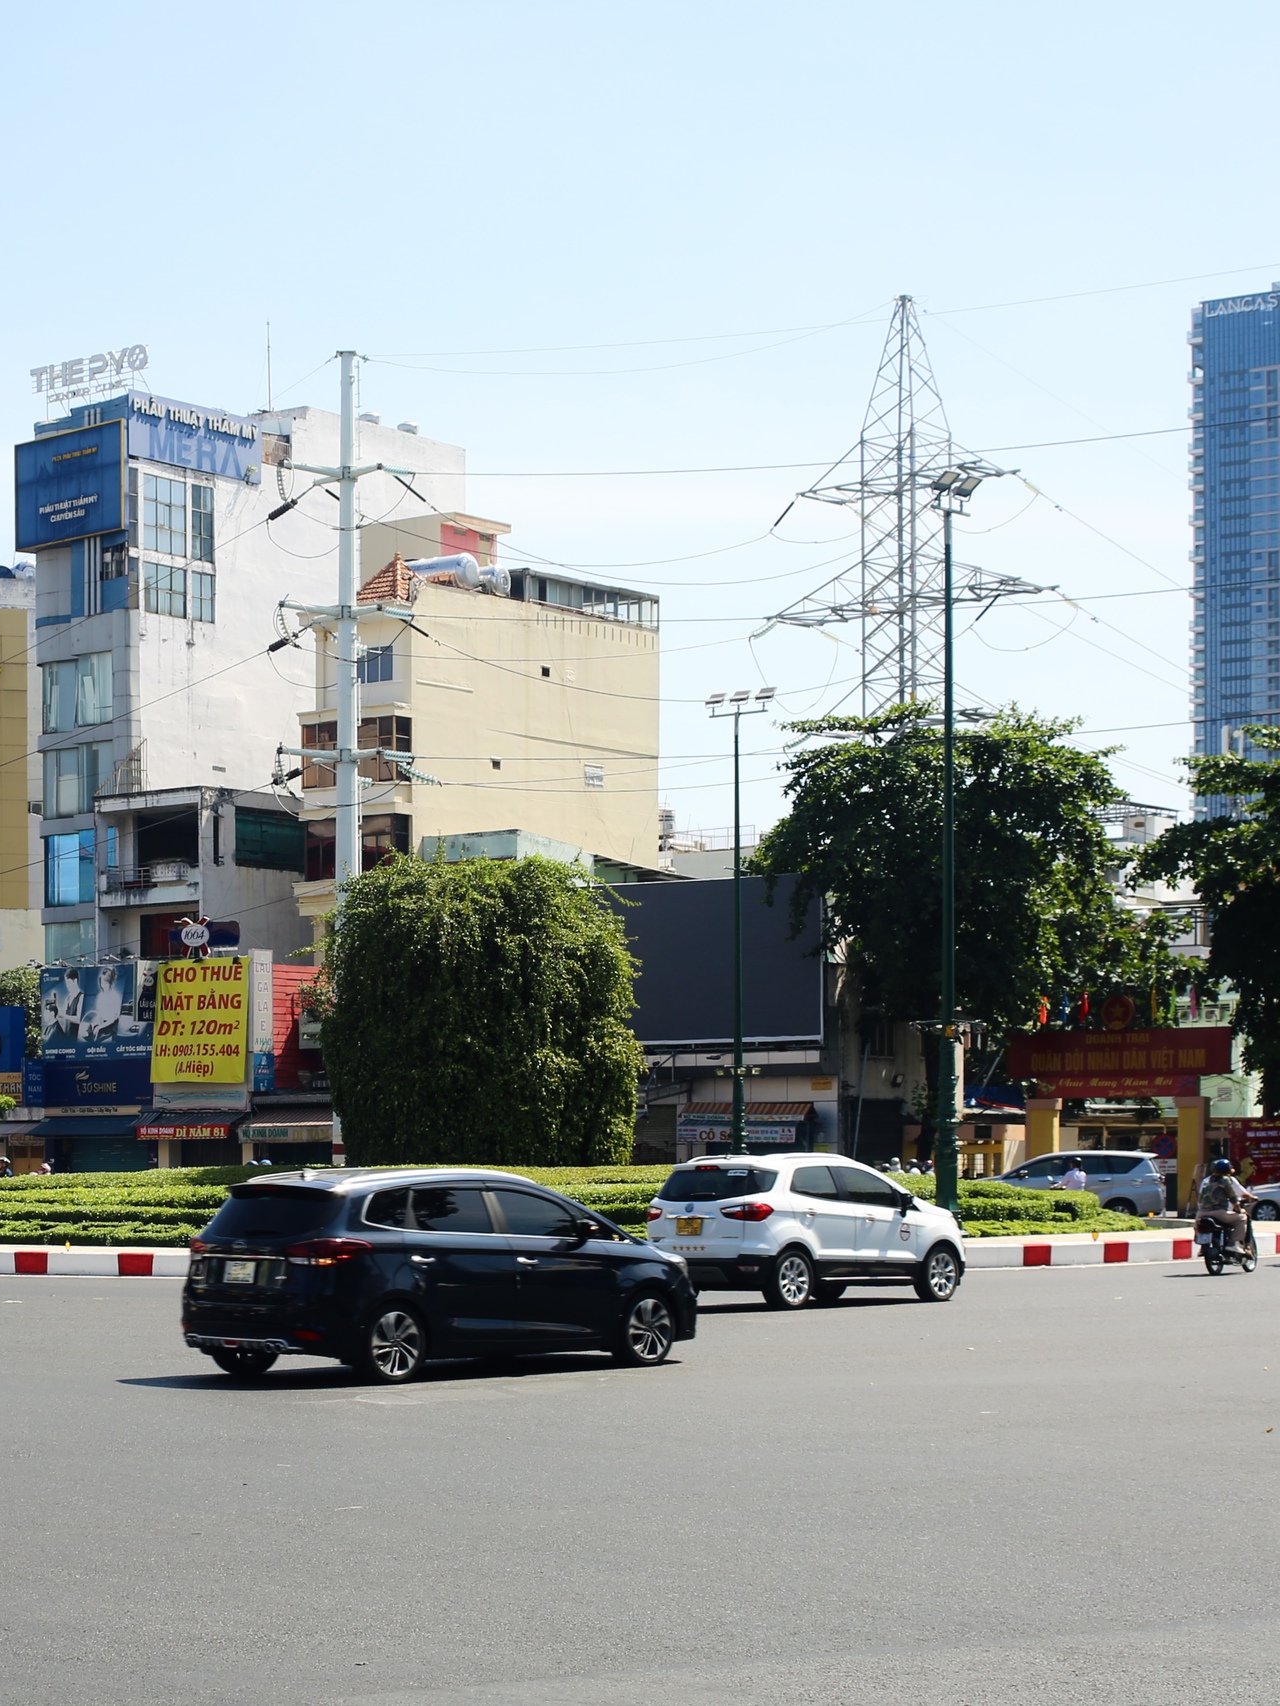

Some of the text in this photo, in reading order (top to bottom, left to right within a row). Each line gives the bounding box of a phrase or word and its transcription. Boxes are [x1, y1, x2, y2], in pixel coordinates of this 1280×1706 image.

[1205, 293, 1280, 317] LANCAS
[183, 928, 206, 940] 1664
[164, 962, 243, 983] CHO THUÊ
[161, 988, 242, 1016] MẶT BẰNG
[1085, 1032, 1149, 1045] DOANH TRẠI
[155, 1043, 240, 1057] LH: 0903.155.404
[1031, 1047, 1206, 1075] QUÂN ĐỘI NHÂN DÂN VIỆT NAM
[175, 1060, 214, 1077] (A.Hiệp)
[175, 1126, 188, 1137] DÌ
[189, 1125, 210, 1137] NĂM
[213, 1126, 225, 1137] 81
[251, 1128, 266, 1138] KINH
[268, 1128, 288, 1138] DOANH
[699, 1128, 715, 1141] CÔ
